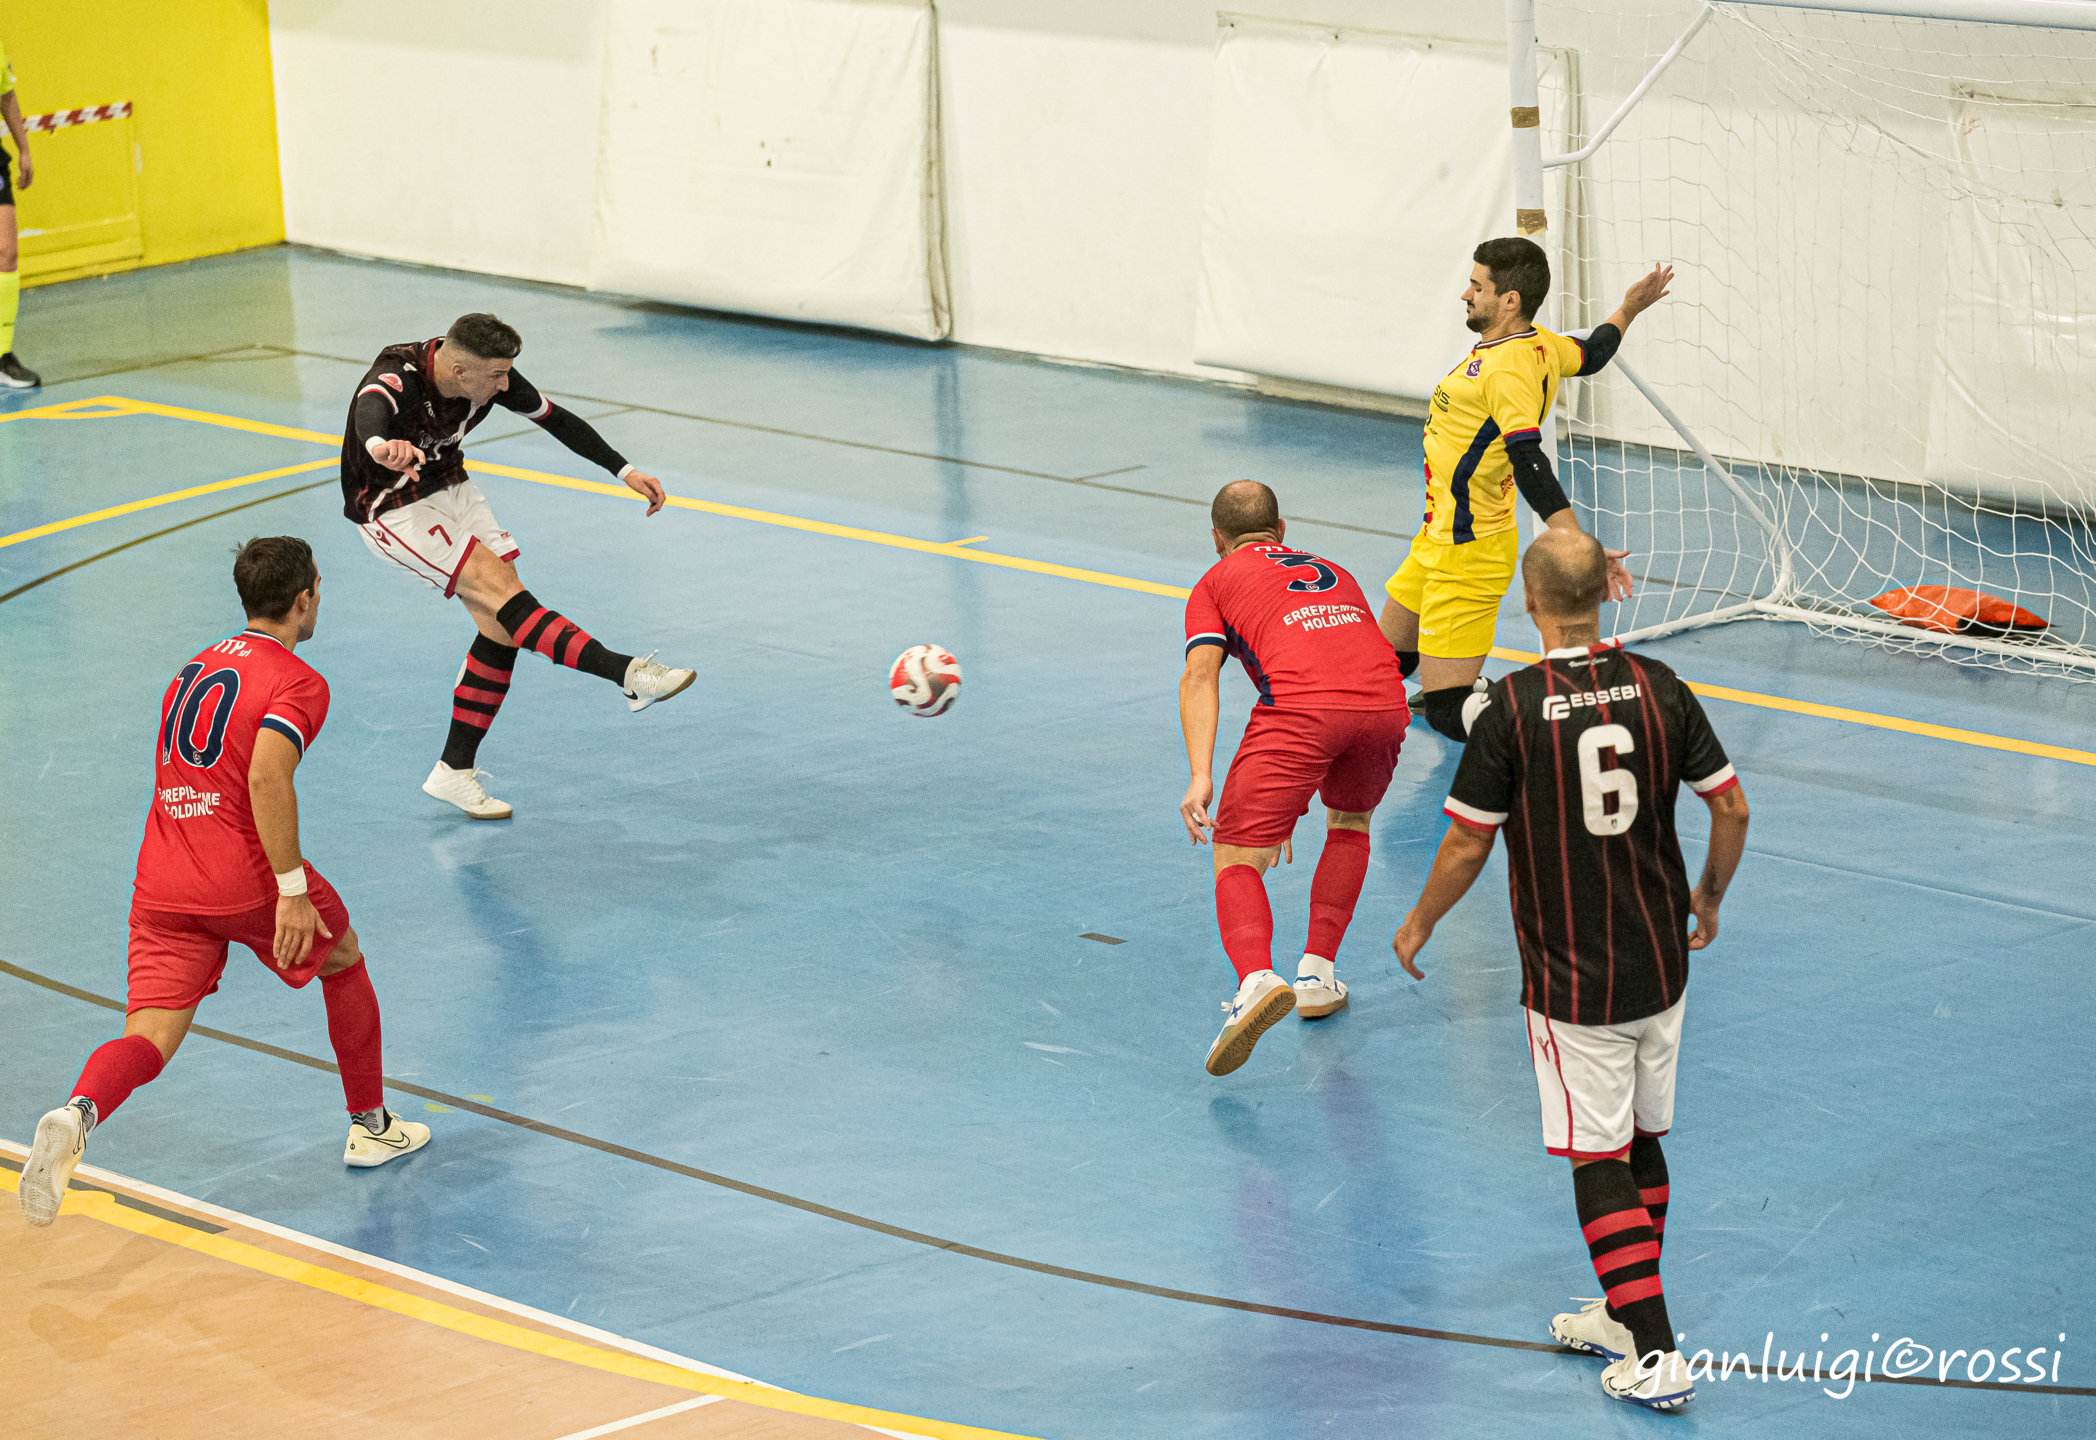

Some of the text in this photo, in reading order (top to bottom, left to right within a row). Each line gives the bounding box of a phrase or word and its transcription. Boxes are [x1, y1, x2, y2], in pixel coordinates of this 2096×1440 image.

[427, 524, 453, 547] 7
[1264, 552, 1339, 593] 3
[1282, 604, 1367, 626] ERREPIEMM
[1301, 612, 1362, 632] HOLDING
[1570, 683, 1642, 708] ESSEBI
[163, 661, 241, 769] 10
[1577, 723, 1639, 836] 6
